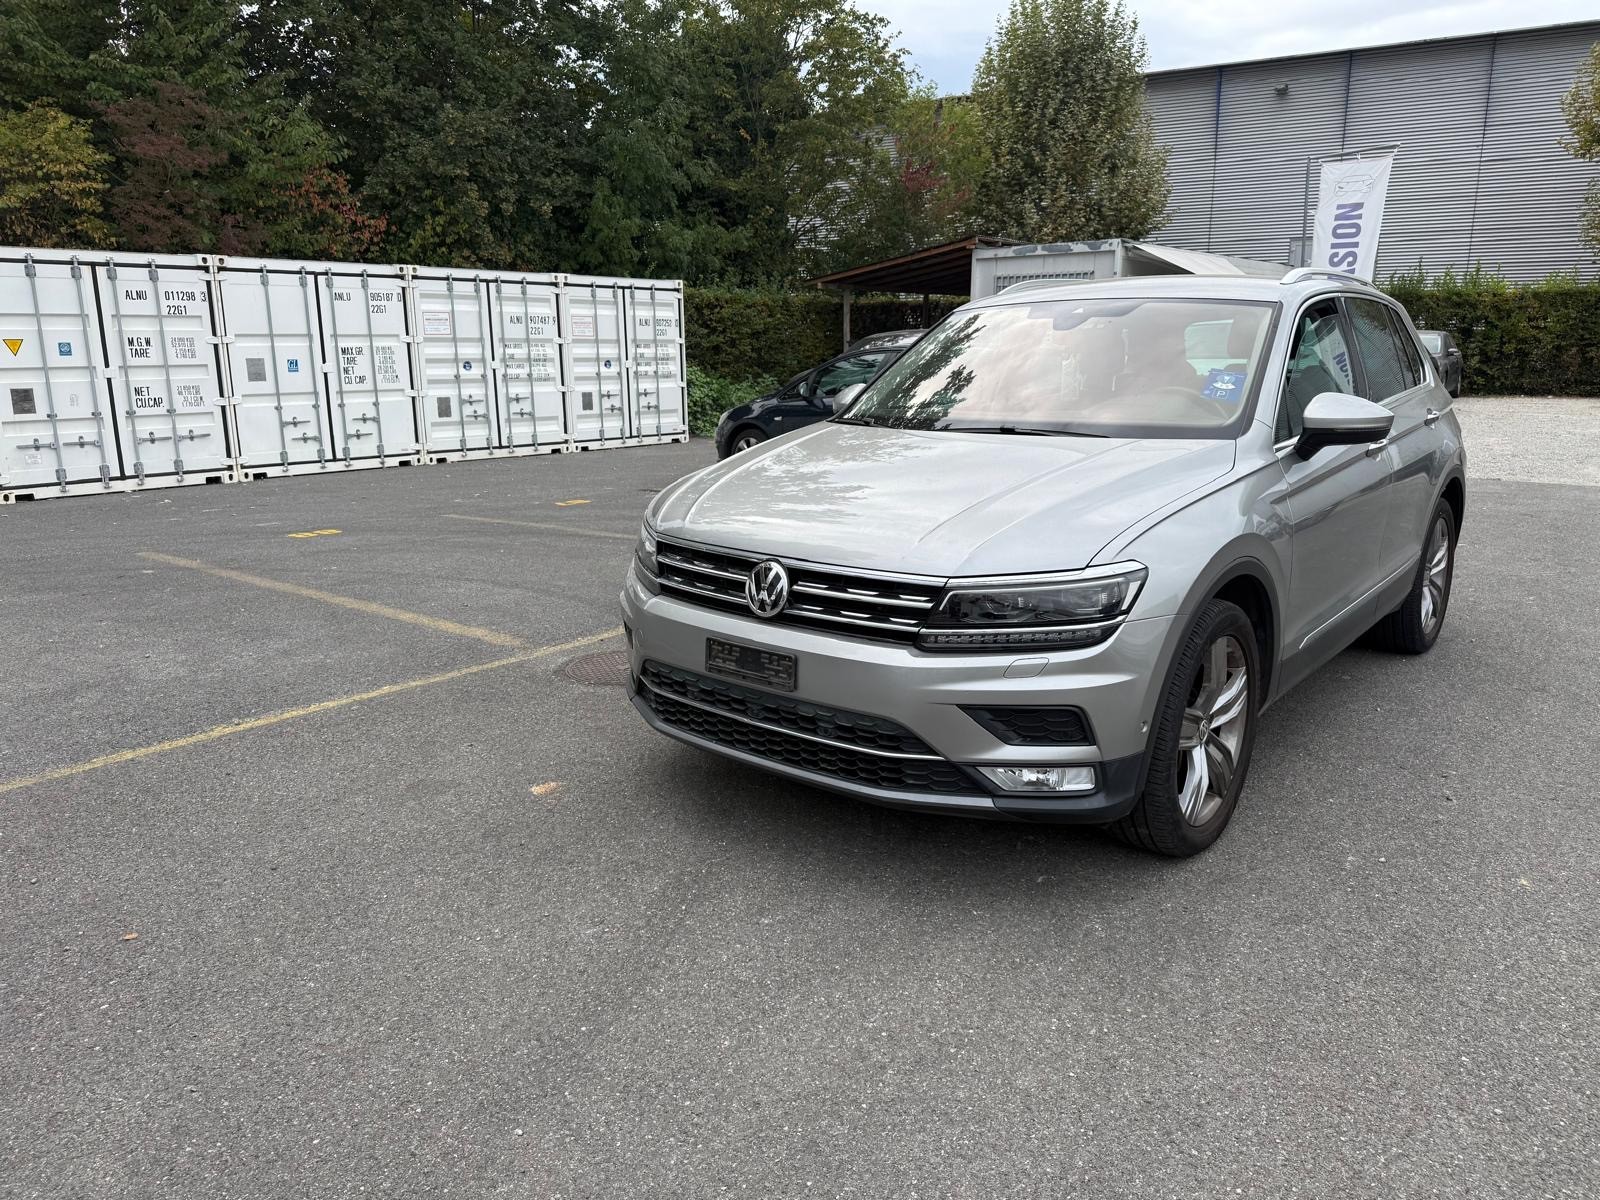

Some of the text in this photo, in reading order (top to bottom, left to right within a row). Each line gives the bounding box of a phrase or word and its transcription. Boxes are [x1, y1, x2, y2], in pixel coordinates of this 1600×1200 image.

[125, 289, 147, 300] ALNU
[164, 290, 196, 302] 011298
[166, 304, 187, 315] 22G1
[129, 348, 151, 359] TARE
[343, 366, 355, 376] NET
[134, 386, 150, 397] NET
